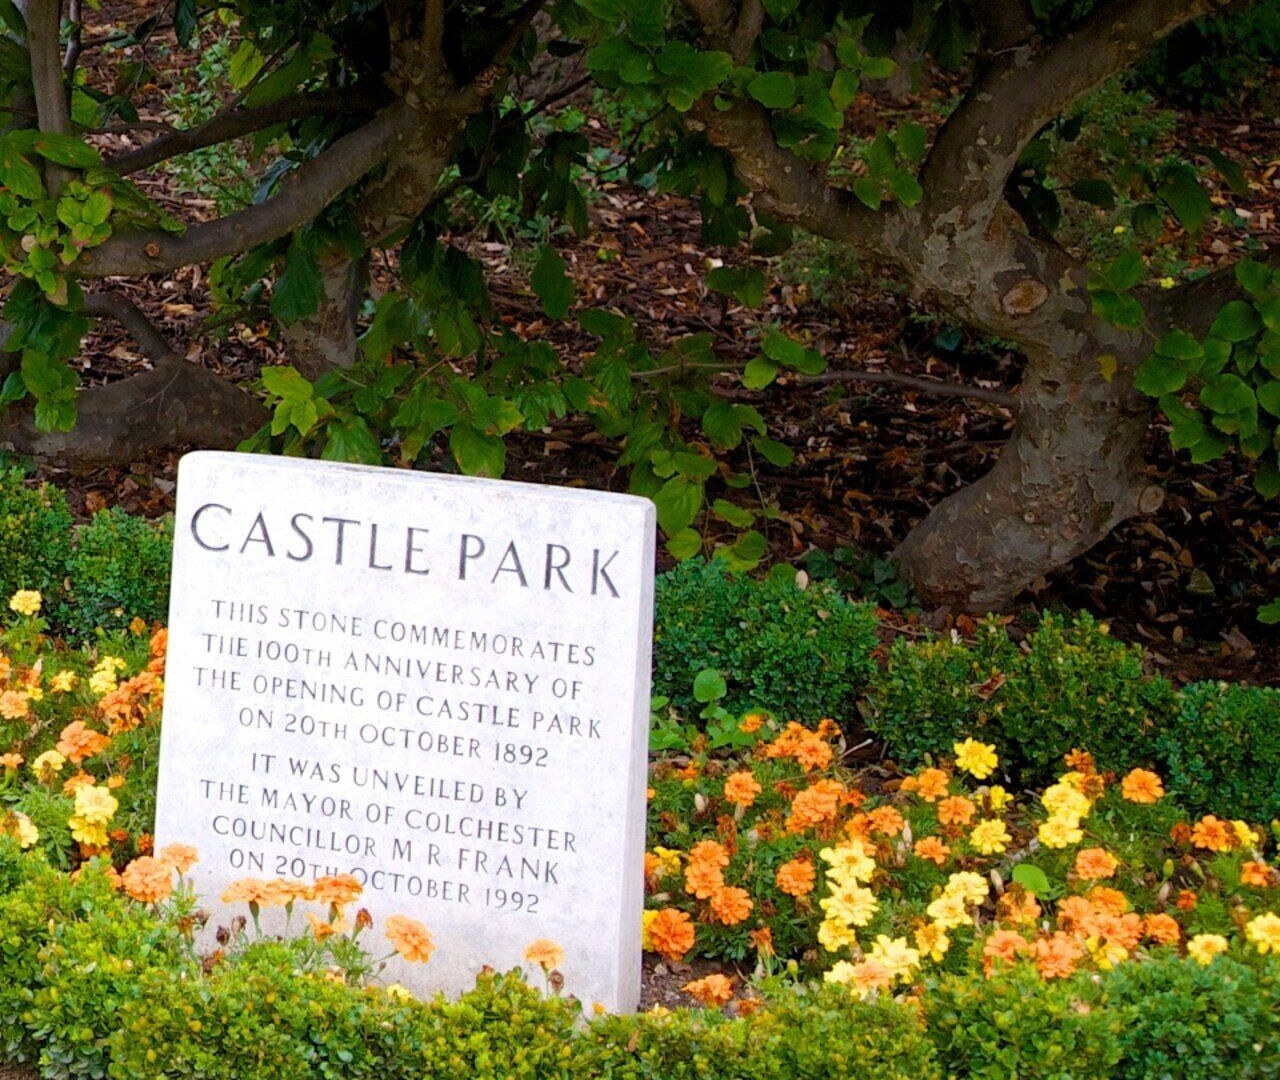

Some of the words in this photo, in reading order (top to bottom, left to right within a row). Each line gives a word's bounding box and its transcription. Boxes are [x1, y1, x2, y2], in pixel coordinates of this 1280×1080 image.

[190, 503, 430, 576] CASTLE
[458, 533, 620, 598] PARK
[202, 632, 248, 658] THE
[257, 640, 331, 667] 100TH
[344, 651, 539, 694] ANNIVERSARY
[551, 677, 583, 700] OF
[211, 599, 268, 625] THIS
[278, 607, 363, 637] STONE
[372, 619, 596, 665] COMMEMORATES
[194, 667, 241, 691] THE
[253, 674, 364, 707] OPENING
[376, 689, 407, 713] OF
[416, 695, 520, 729] CASTLE
[532, 711, 601, 740] PARK
[238, 707, 273, 729] ON
[284, 712, 348, 740] 20TH
[359, 723, 481, 759] OCTOBER
[495, 742, 549, 768] 1892
[251, 752, 277, 774] IT
[288, 757, 341, 784] WAS
[353, 766, 484, 804] UNVEILED
[494, 787, 528, 810] BY
[199, 779, 249, 805] THE
[261, 787, 353, 821] MAYOR
[365, 803, 395, 825] OF
[404, 809, 577, 852] COLCHESTER
[212, 815, 377, 857] COUNCILLOR
[392, 837, 412, 863] M
[427, 843, 444, 867] R
[457, 849, 559, 885] FRANK
[229, 848, 265, 872] ON
[275, 855, 340, 877] 20TH
[349, 866, 470, 904] OCTOBER
[486, 887, 540, 914] 1992
